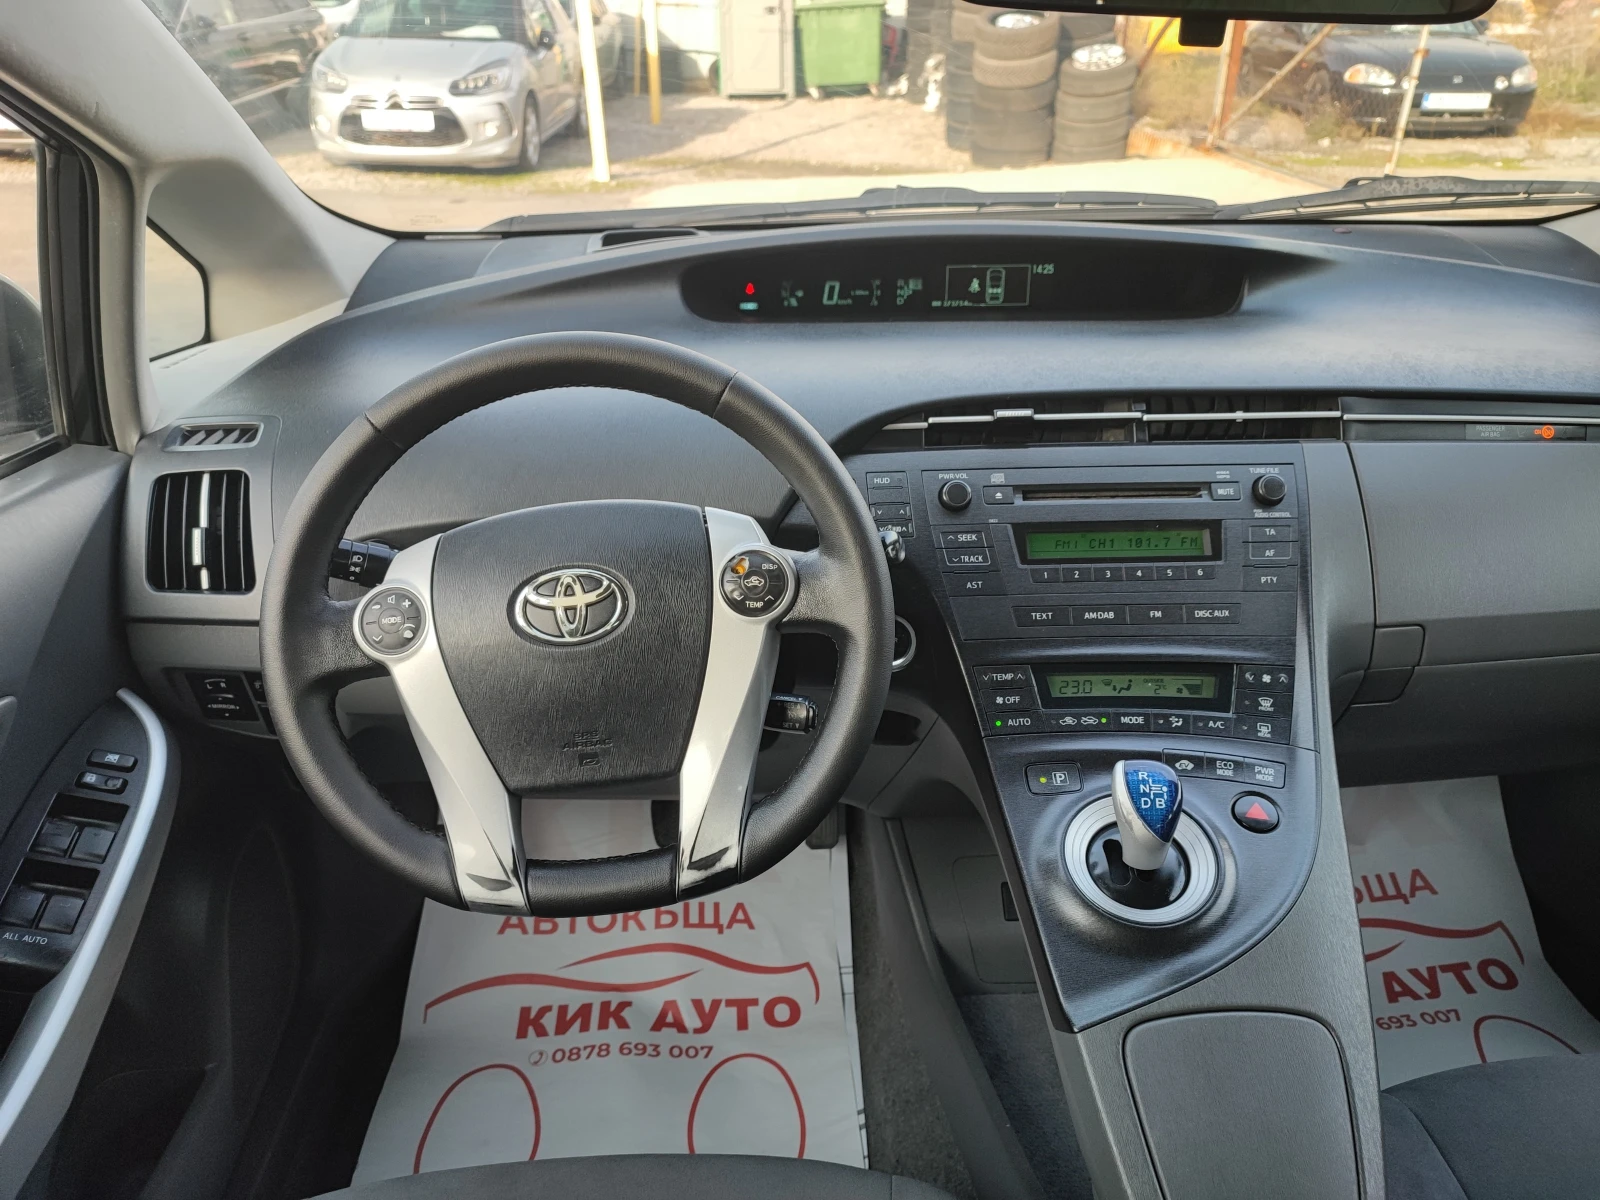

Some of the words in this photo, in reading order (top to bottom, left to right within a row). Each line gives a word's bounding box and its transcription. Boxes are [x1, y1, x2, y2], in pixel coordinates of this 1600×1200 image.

[1264, 528, 1276, 536] TA
[957, 533, 978, 542] SEEK
[1088, 537, 1115, 549] CH1
[1127, 536, 1172, 548] 101.7
[1180, 535, 1198, 547] FM
[1265, 549, 1275, 557] AF
[960, 555, 983, 563] TRACK
[1043, 571, 1048, 579] 1
[1074, 570, 1080, 578] 2
[1105, 570, 1111, 578] 3
[1136, 569, 1142, 577] 4
[1167, 568, 1173, 577] 5
[1197, 568, 1204, 576] 6
[1260, 576, 1278, 584] PTY
[966, 581, 983, 589] AST
[1031, 612, 1053, 620] TEXT
[1150, 610, 1162, 618] FM
[381, 616, 402, 624] MODE
[992, 673, 1014, 681] TEMP
[1059, 680, 1093, 694] 23.0
[1005, 696, 1021, 704] OFF
[1007, 718, 1031, 726] AUTO
[1120, 716, 1145, 724] MODE
[1208, 721, 1225, 729] A/C
[1216, 761, 1234, 769] ECO
[1254, 766, 1275, 775] PWR
[1055, 773, 1066, 784] P
[1138, 771, 1149, 780] R
[1255, 773, 1274, 782] MODE
[1140, 784, 1150, 793] N
[1141, 797, 1151, 808] D
[1155, 797, 1166, 808] B
[2, 932, 19, 940] ALL
[21, 934, 48, 945] AUTO
[1382, 957, 1519, 1004] АУТО
[515, 1000, 633, 1039] КИК
[649, 996, 802, 1034] АУТО
[1375, 1013, 1417, 1031] 693
[1419, 1008, 1462, 1025] 007
[551, 1043, 611, 1063] 0878
[618, 1041, 661, 1058] 693
[668, 1045, 714, 1060] 007
